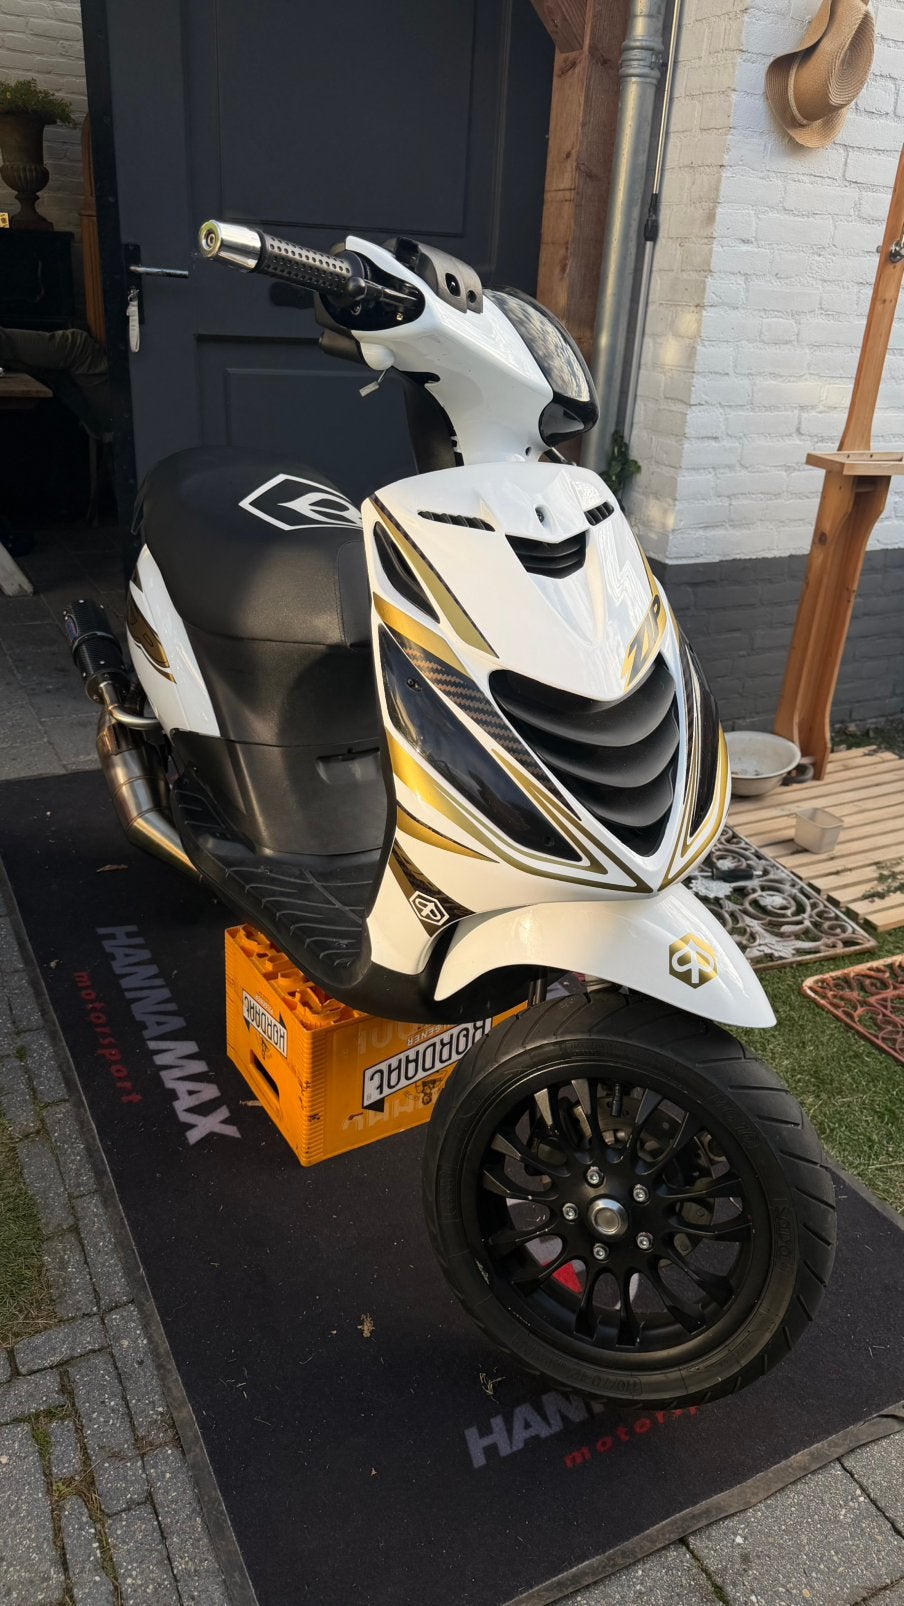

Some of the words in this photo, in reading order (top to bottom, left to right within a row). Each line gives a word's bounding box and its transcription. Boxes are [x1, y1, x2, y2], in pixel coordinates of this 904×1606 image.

[627, 595, 661, 687] ZIP
[74, 971, 143, 1104] motorsport
[96, 925, 242, 1146] HANNAMAX
